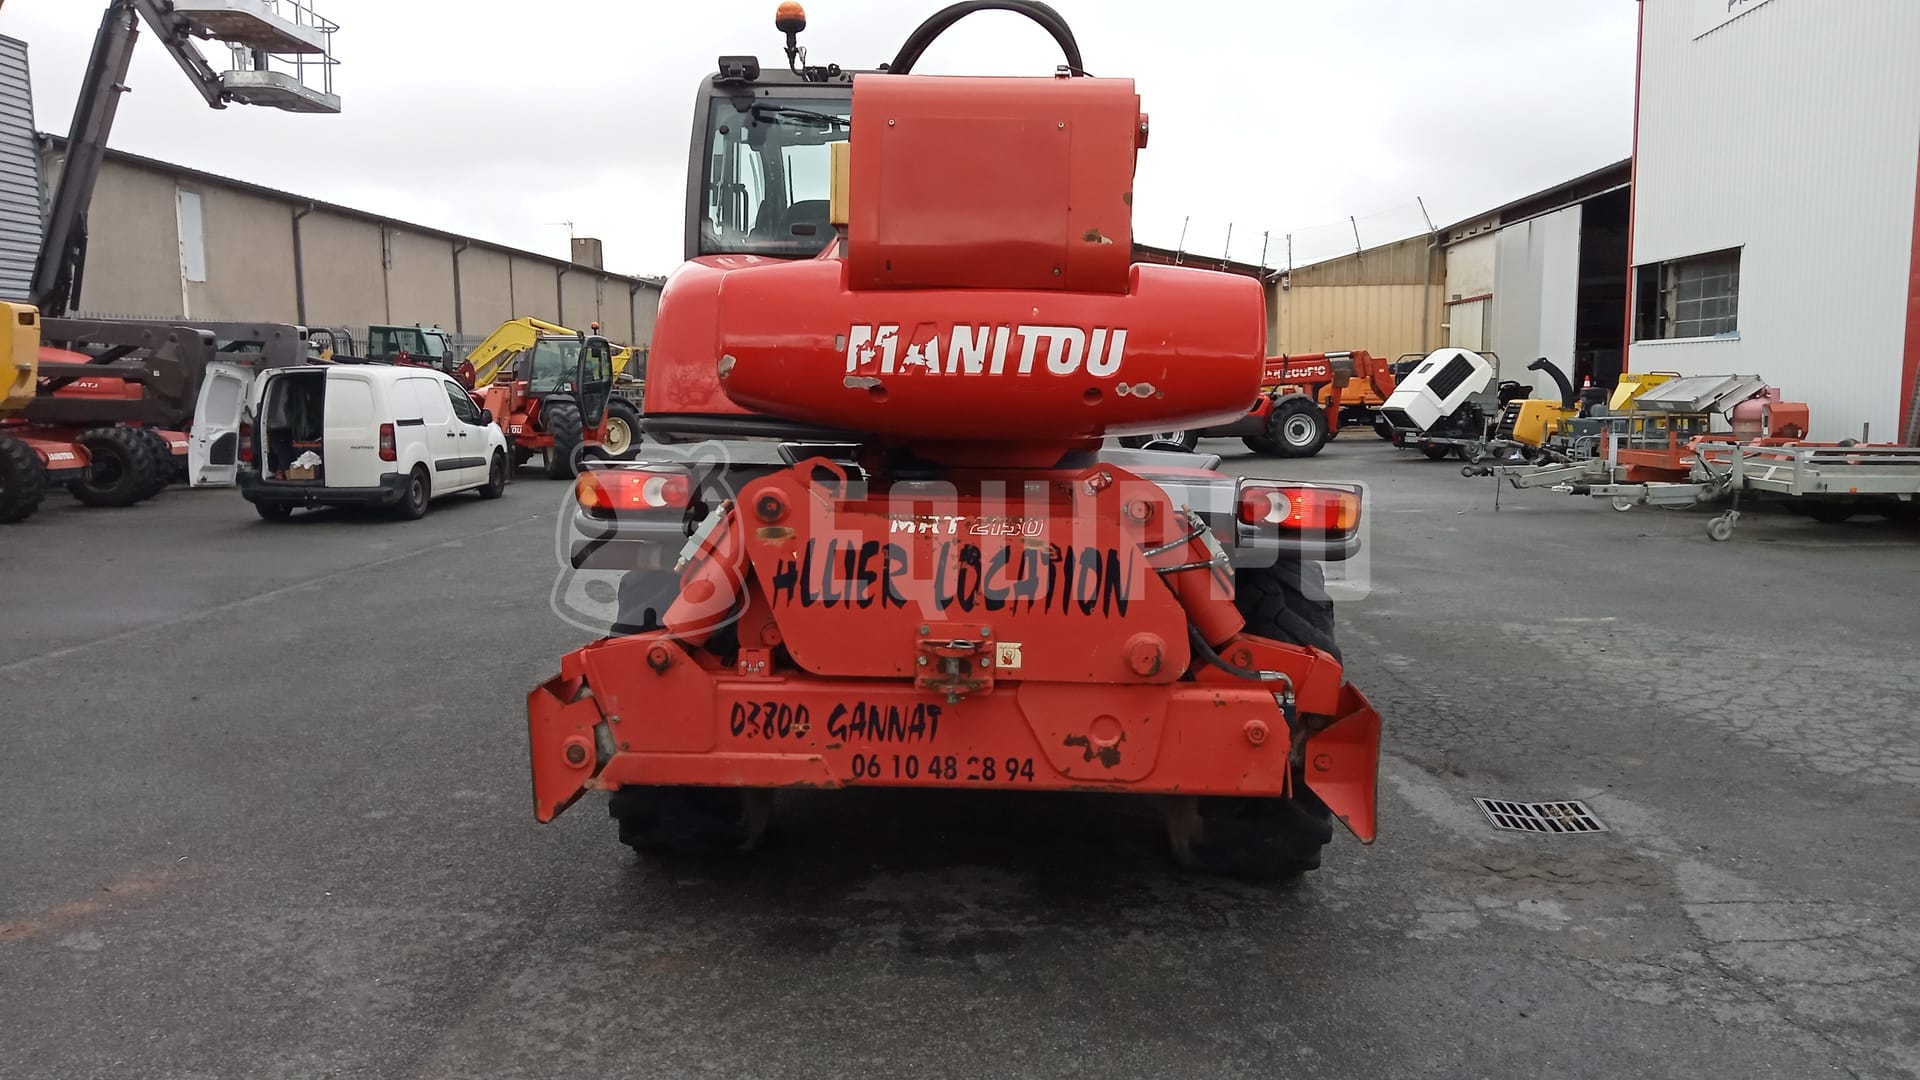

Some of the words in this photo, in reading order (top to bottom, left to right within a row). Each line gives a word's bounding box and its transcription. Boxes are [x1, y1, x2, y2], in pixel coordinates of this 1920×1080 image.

[845, 323, 1128, 377] MANITOU
[890, 515, 966, 535] MRT
[933, 540, 1135, 619] LOCATION
[730, 701, 810, 740] 03800
[827, 701, 942, 743] GANNAT
[851, 753, 881, 779] 06
[892, 754, 920, 780] 10
[927, 755, 958, 781] 48
[1004, 757, 1035, 783] 94
